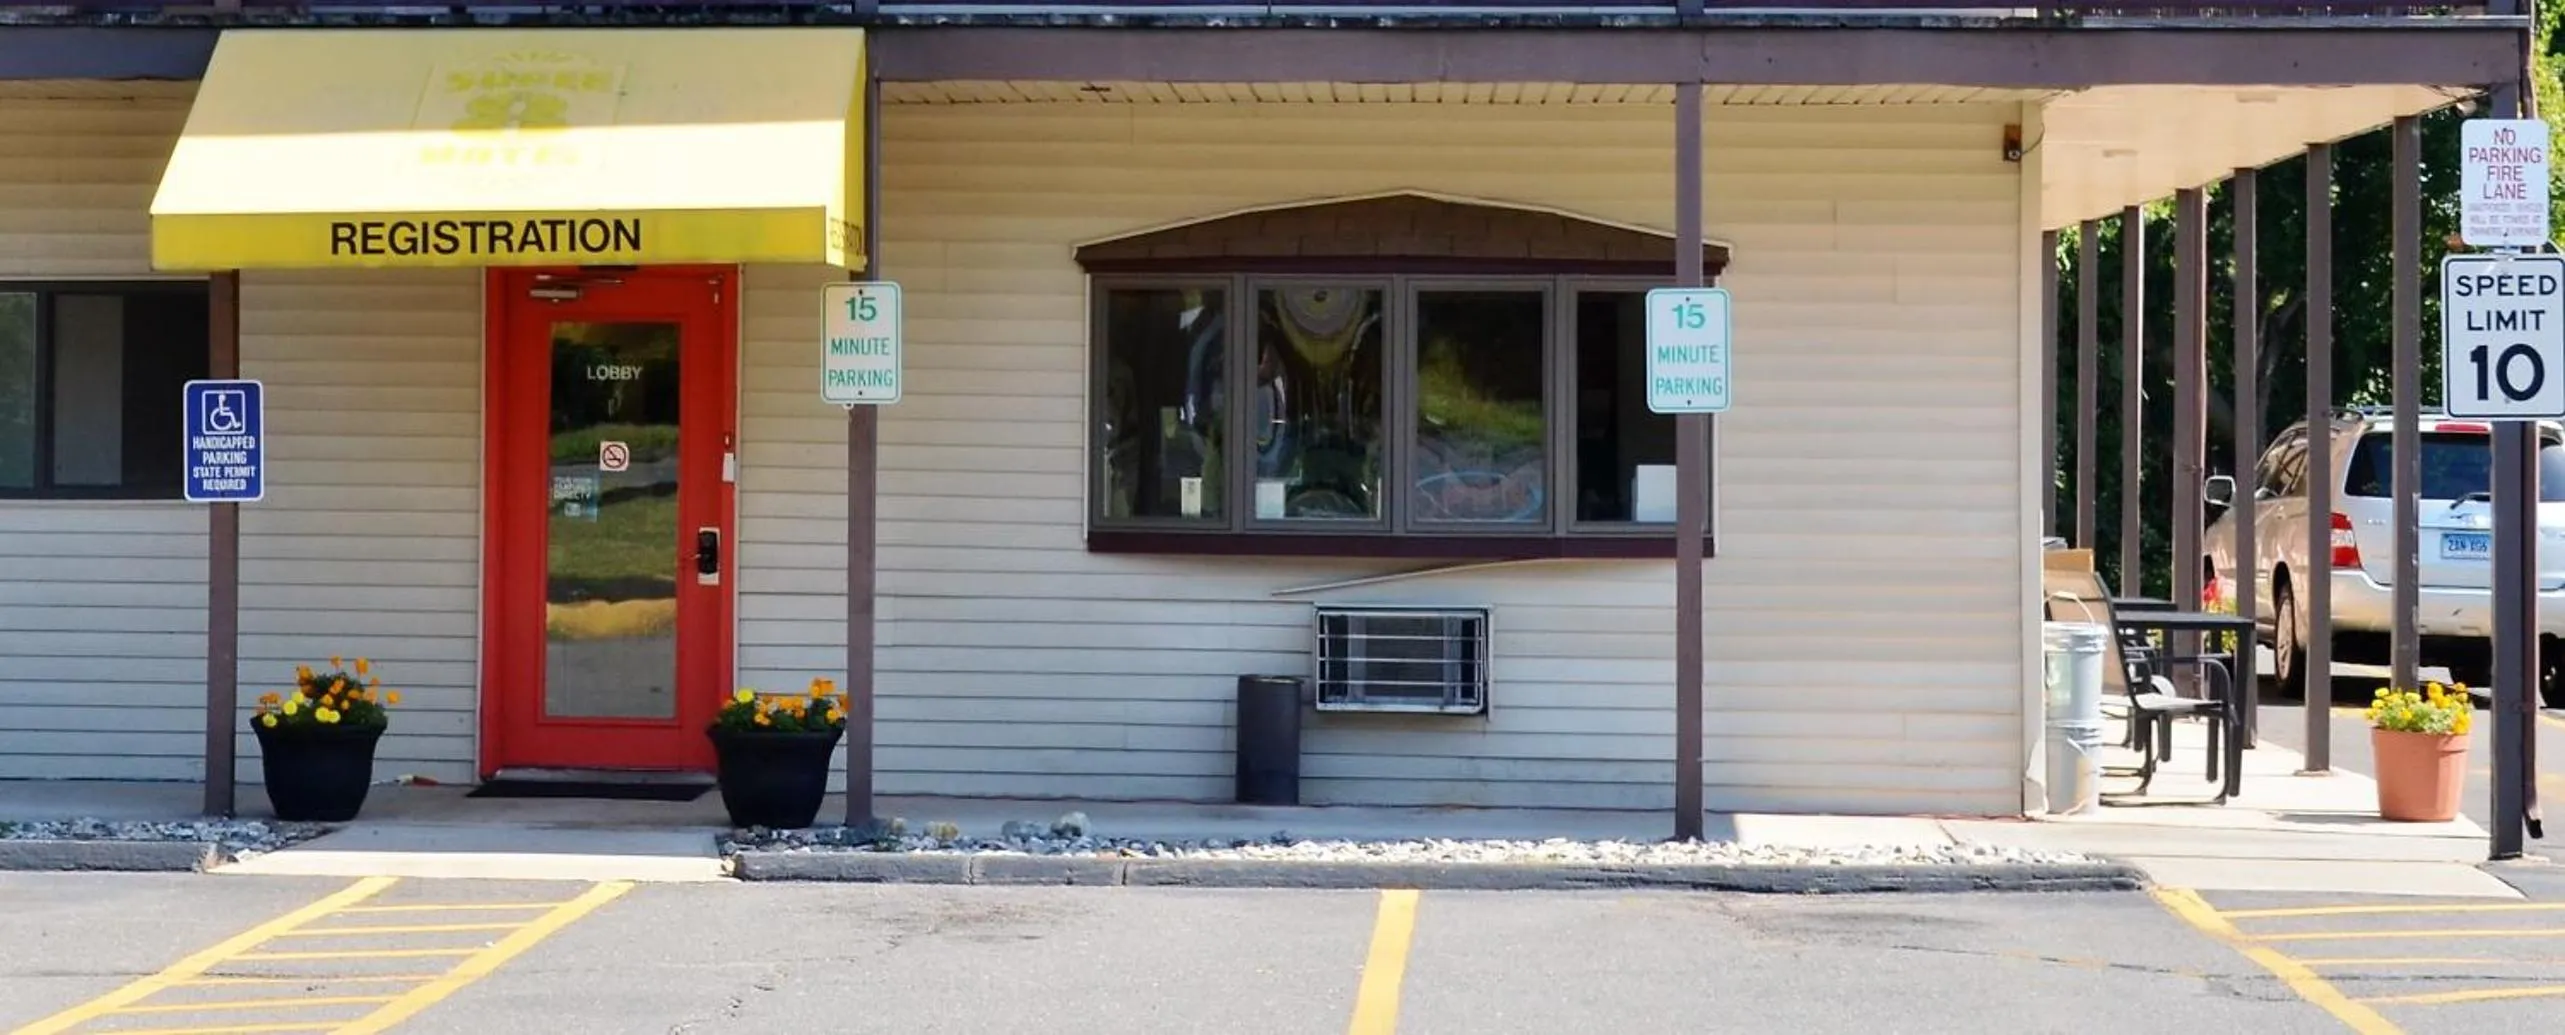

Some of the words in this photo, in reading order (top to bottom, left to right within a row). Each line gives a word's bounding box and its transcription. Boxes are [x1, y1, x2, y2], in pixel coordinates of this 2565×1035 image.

[2494, 128, 2516, 145] NO
[2469, 147, 2542, 164] PARKING
[2487, 165, 2524, 182] FIRE
[2483, 183, 2527, 200] LANE
[331, 218, 641, 255] REGISTRATION
[2456, 274, 2557, 297] SPEED
[845, 297, 877, 321] 15
[1672, 304, 1706, 329] 15
[2467, 310, 2545, 331] LIMIT
[831, 337, 890, 355] MINUTE
[1657, 344, 1720, 364] MINUTE
[587, 365, 643, 380] LOBBY
[828, 368, 893, 387] PARKING
[2470, 343, 2545, 402] 10
[1656, 376, 1722, 396] PARKING
[193, 435, 255, 450] HANDICAPPED
[203, 451, 247, 465] PARKING
[193, 466, 221, 478] STATE
[224, 466, 256, 478] PERMIT
[203, 478, 247, 491] REQUIRED
